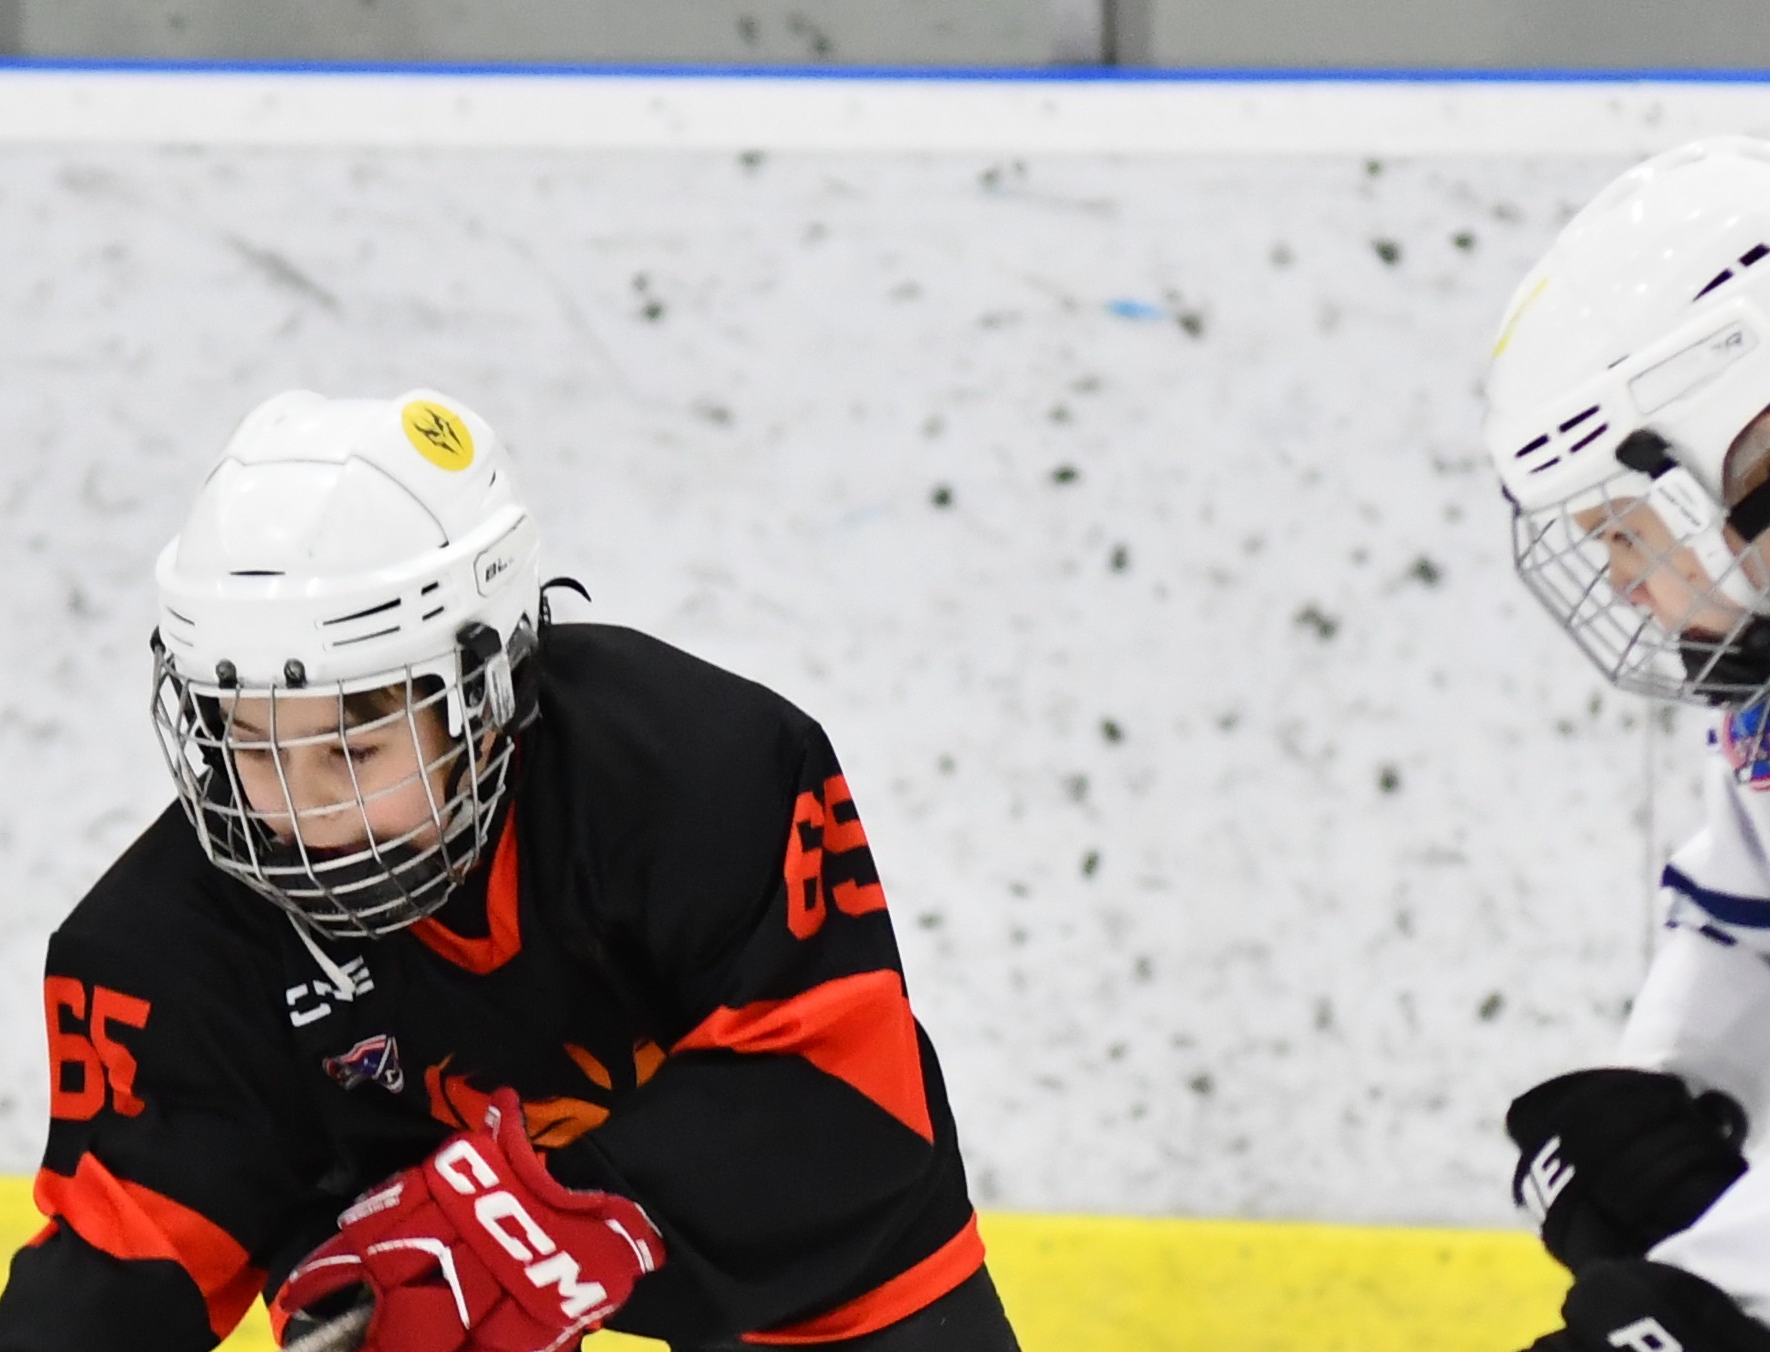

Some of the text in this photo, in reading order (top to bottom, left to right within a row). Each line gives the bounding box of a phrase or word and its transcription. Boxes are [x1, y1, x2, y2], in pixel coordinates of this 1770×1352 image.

[784, 774, 889, 940] 65
[44, 976, 152, 1122] 65
[434, 1139, 608, 1320] CCM
